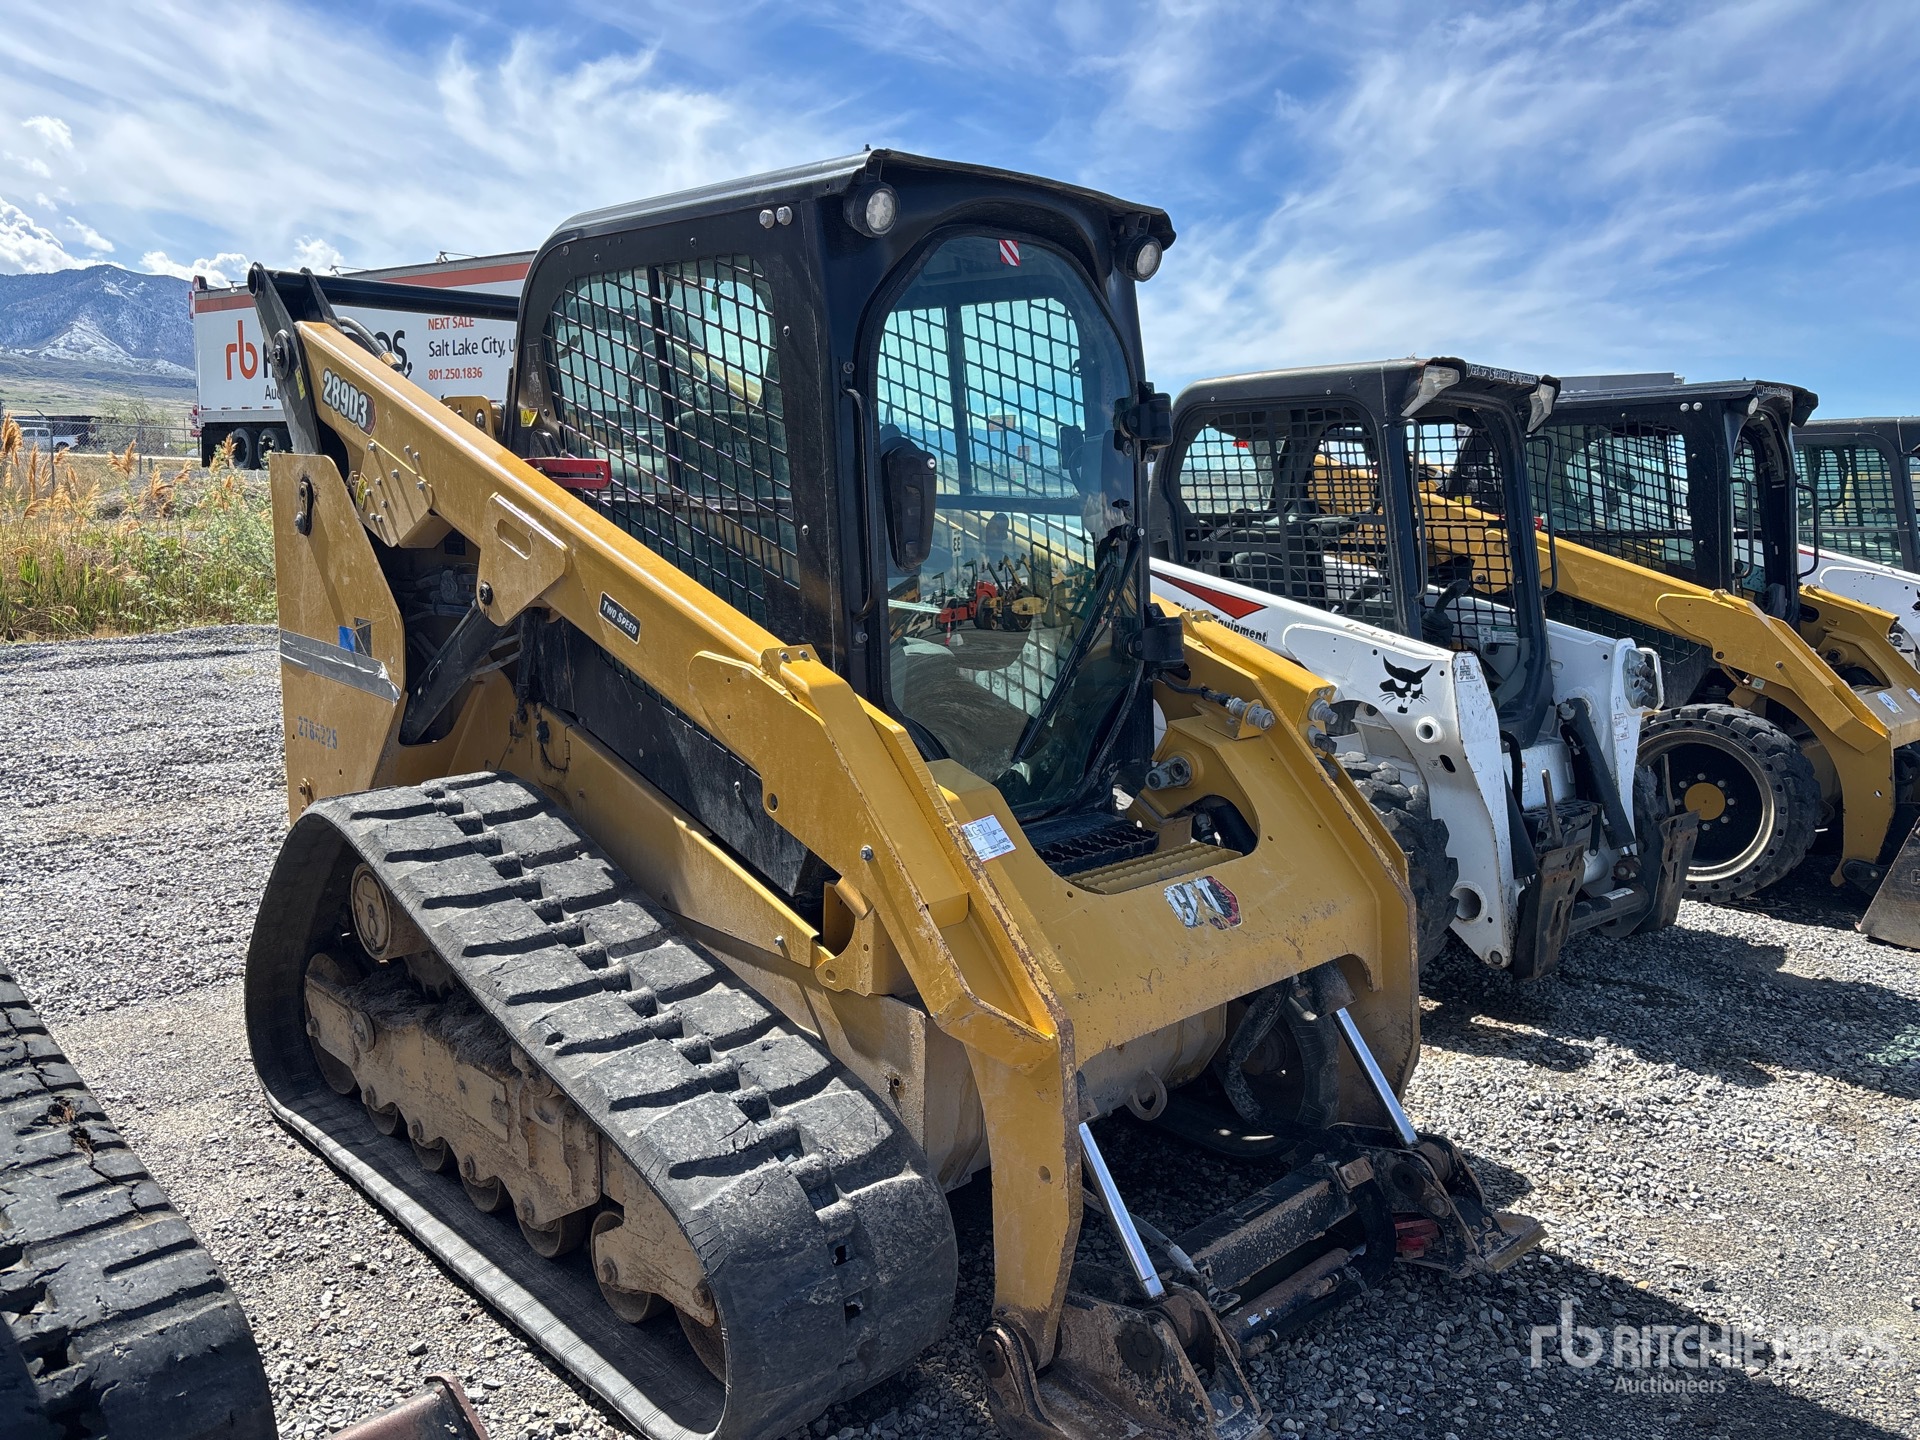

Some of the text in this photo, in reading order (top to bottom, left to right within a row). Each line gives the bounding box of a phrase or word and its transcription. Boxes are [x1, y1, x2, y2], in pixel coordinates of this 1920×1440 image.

[428, 316, 474, 330] NEXT SALE
[226, 320, 258, 380] rb
[428, 339, 449, 357] Salt
[452, 338, 478, 356] Lake
[481, 336, 506, 358] City,
[428, 367, 483, 380] 801.250.1836
[322, 369, 368, 429] 289D3
[602, 600, 637, 635] TWO SPEED
[1212, 614, 1268, 644] quipment
